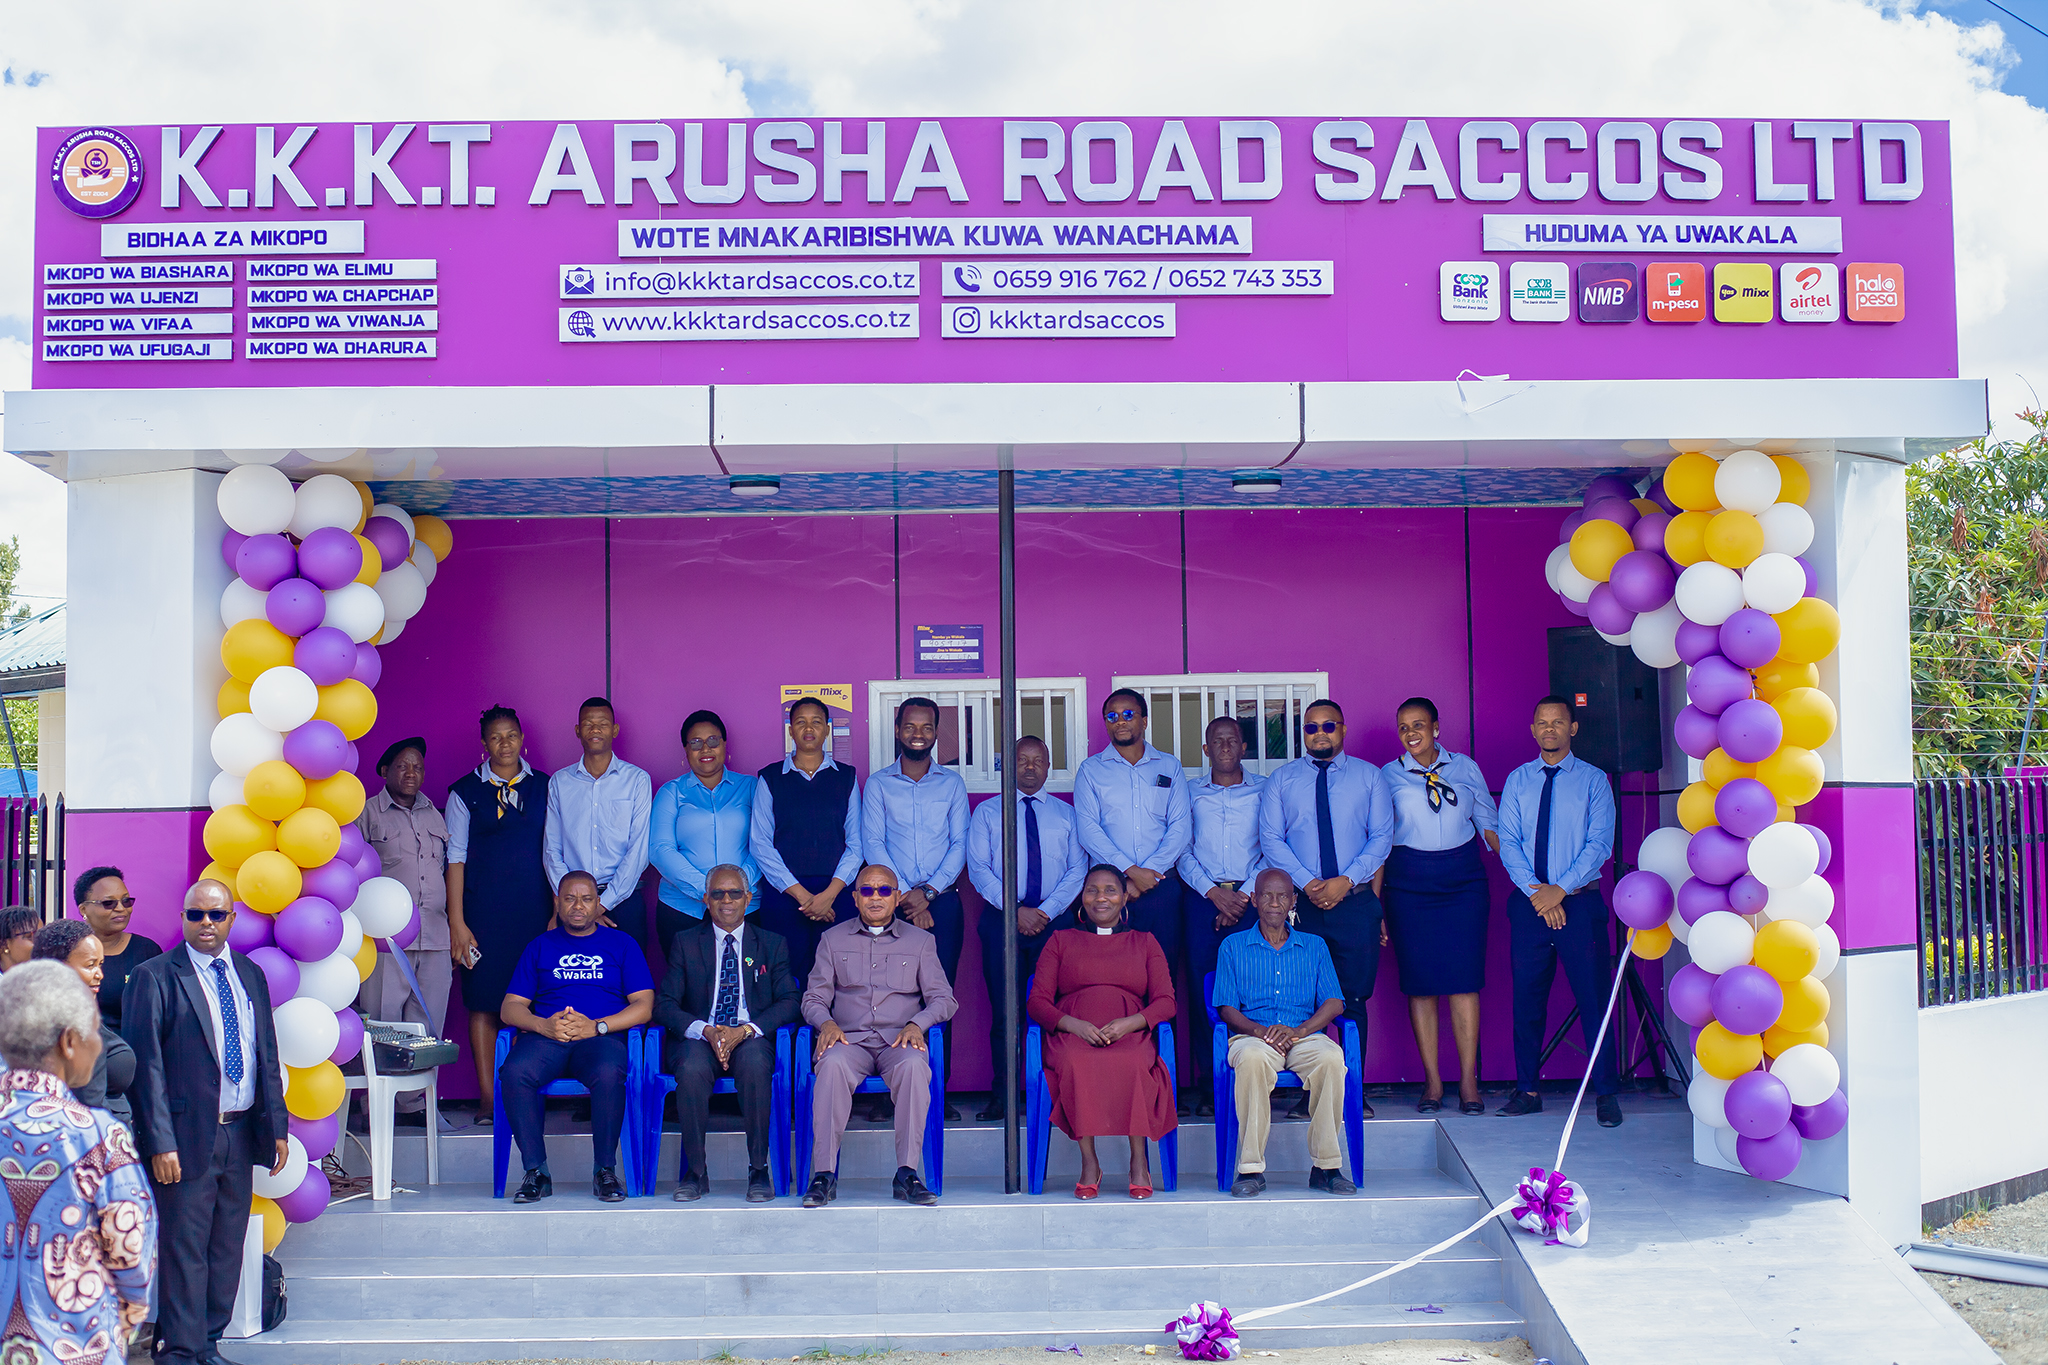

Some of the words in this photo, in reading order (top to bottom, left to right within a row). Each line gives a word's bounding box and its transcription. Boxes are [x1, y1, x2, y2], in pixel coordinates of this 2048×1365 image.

[67, 131, 93, 147] ARUSHA
[95, 130, 114, 138] ROAD
[114, 136, 135, 159] SACCOS
[161, 124, 495, 208] K.K.K.T.
[528, 121, 969, 205] ARUSHA
[1003, 120, 1283, 203] ROAD
[1312, 120, 1723, 203] SACCOS
[1753, 121, 1924, 203] LTD
[128, 232, 207, 248] BIDHAA
[214, 231, 243, 246] ZA
[251, 230, 327, 245] MIKOPO
[631, 228, 709, 248] WOTE
[719, 226, 954, 247] MNAKARIBISHWA
[964, 226, 1043, 246] KUWA
[1053, 225, 1239, 245] WANACHAMA
[1526, 224, 1628, 242] HUDUMA
[1636, 225, 1668, 243] YA
[1676, 225, 1797, 243] UWAKALA
[48, 268, 104, 280] MKOPO
[110, 267, 135, 279] WA
[141, 266, 229, 278] BIASHARA
[251, 264, 308, 276] MKOPO
[314, 264, 339, 276] WA
[345, 264, 393, 275] ELIMU
[606, 271, 915, 295] info@kkktardsaccos.co.tz
[994, 270, 1051, 288] 0659
[1060, 270, 1097, 287] 916
[1105, 270, 1146, 287] 762
[1153, 267, 1162, 290] /
[1169, 270, 1226, 287] 0652
[1234, 270, 1274, 287] 743
[1282, 270, 1321, 287] 353
[1855, 274, 1896, 292] halo
[48, 293, 104, 305] MKOPO
[110, 292, 135, 304] WA
[141, 292, 198, 304] UJENZI
[252, 290, 307, 302] MKOPO
[313, 290, 338, 302] WA
[343, 289, 433, 302] CHAPCHAP
[1453, 285, 1488, 298] Bank
[1584, 286, 1624, 305] NMB
[1652, 300, 1698, 312] m-pesa
[1790, 294, 1832, 308] airtel
[1856, 294, 1896, 311] pesa
[48, 319, 104, 331] MKOPO
[110, 319, 135, 331] WA
[141, 318, 193, 330] VIFAA
[252, 316, 309, 328] MKOPO
[315, 316, 340, 328] WA
[347, 314, 425, 327] VIWANJA
[603, 311, 910, 331] www.kkktardsaccos.co.tz
[991, 310, 1164, 329] kkktardsaccos
[47, 344, 103, 357] MKOPO
[109, 344, 134, 356] WA
[140, 344, 210, 356] UFUGAJI
[251, 342, 307, 354] MKOPO
[313, 342, 339, 354] WA
[345, 342, 427, 354] DHARURA
[563, 970, 603, 979] Wakala
